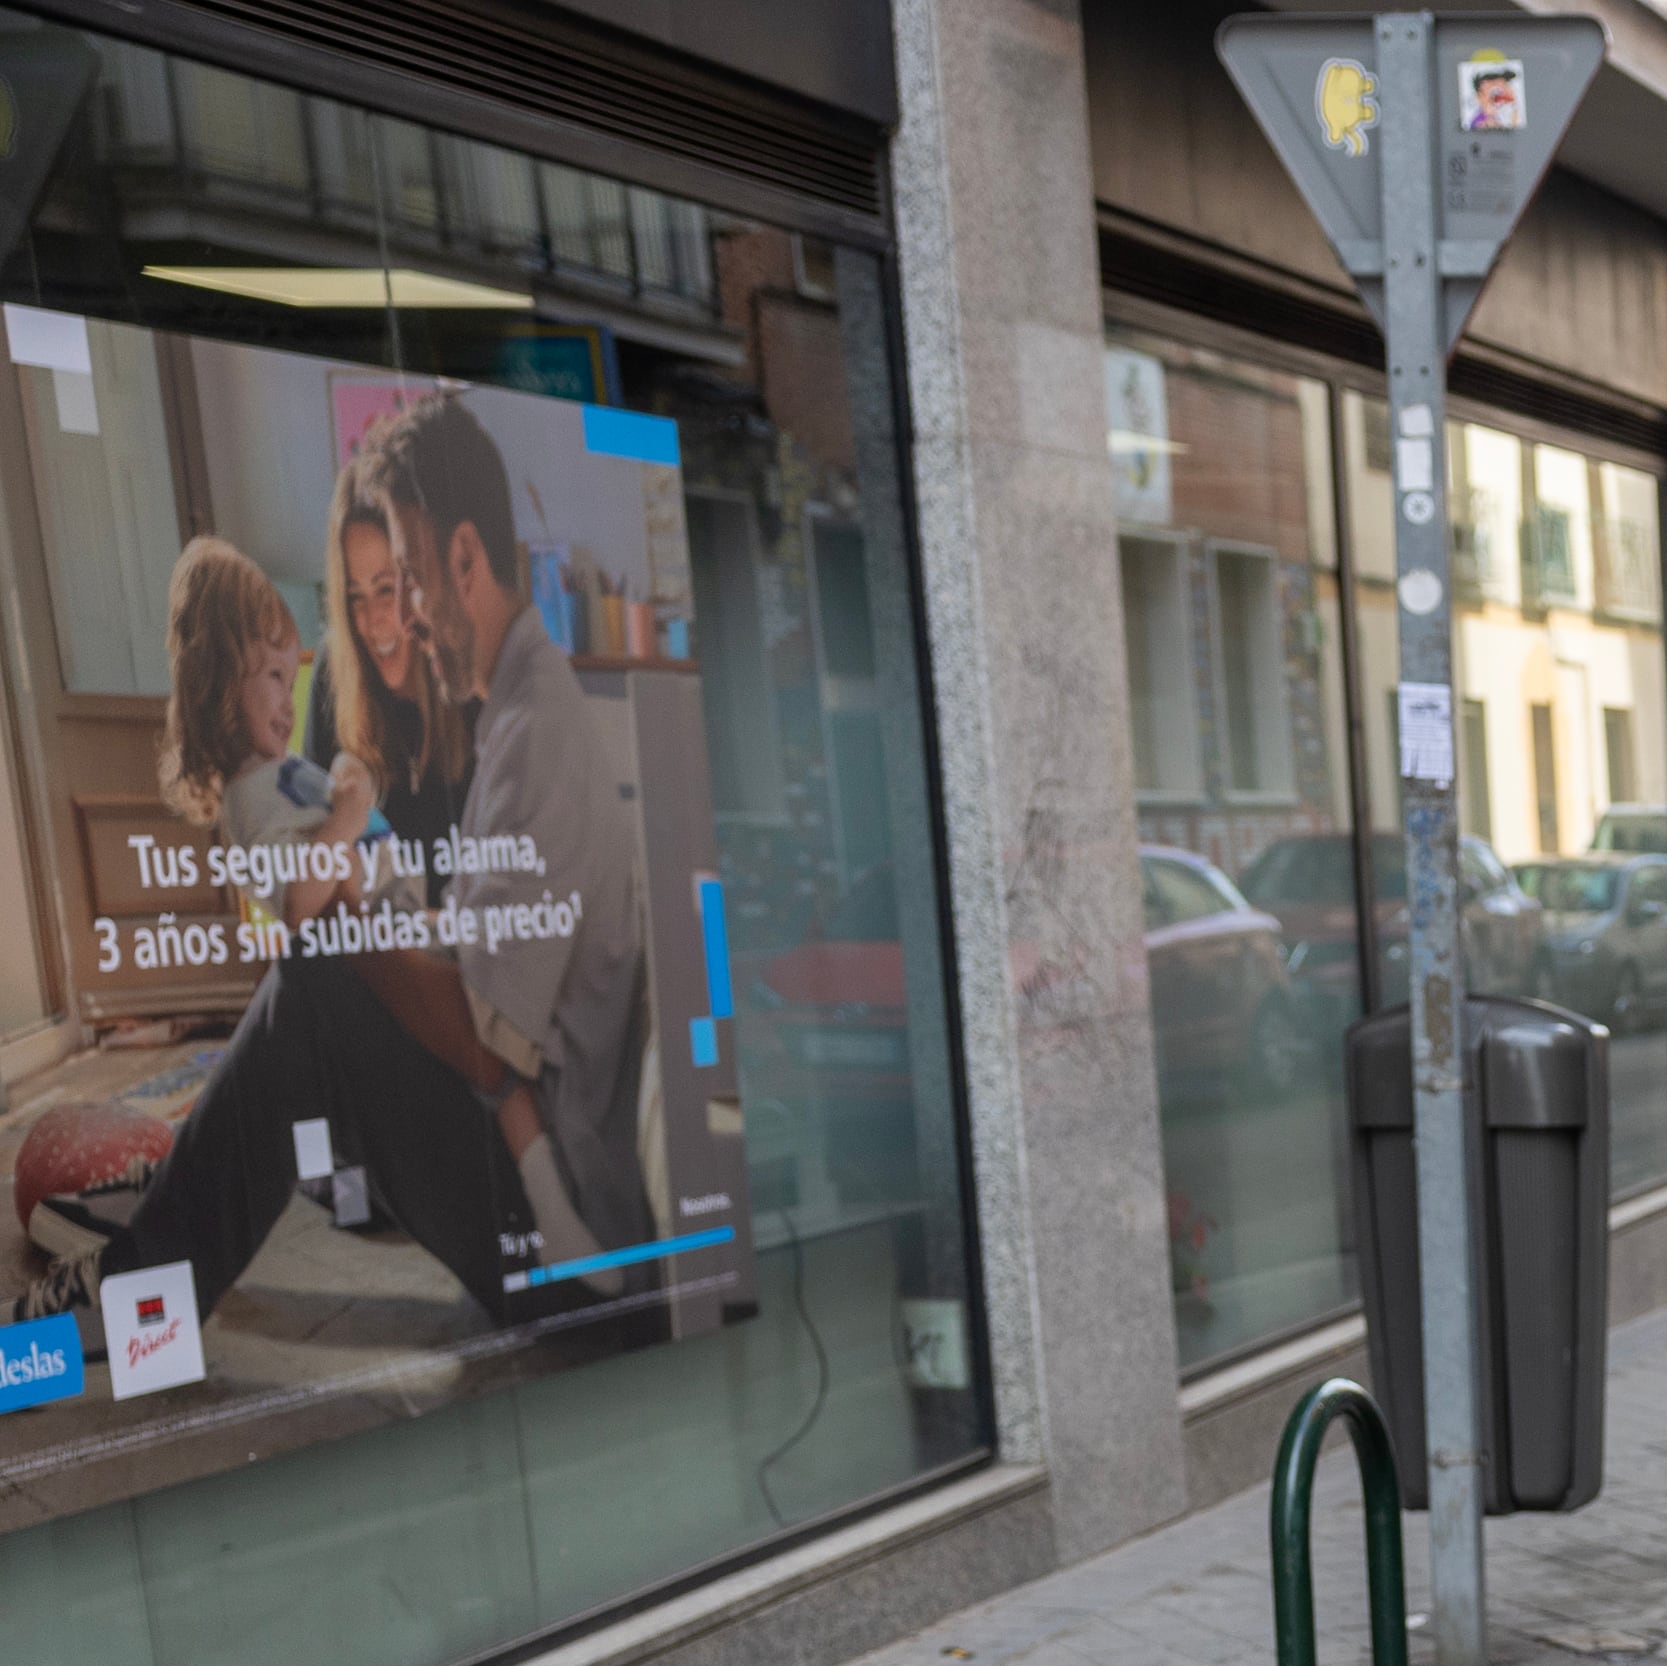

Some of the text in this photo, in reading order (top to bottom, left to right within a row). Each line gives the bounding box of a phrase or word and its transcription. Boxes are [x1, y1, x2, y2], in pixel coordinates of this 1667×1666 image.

[128, 834, 199, 889] Tus
[206, 838, 352, 898] seguros
[356, 836, 380, 892] y
[387, 831, 426, 878] tu
[94, 916, 122, 973] 3
[133, 911, 229, 970] años
[237, 906, 293, 963] sin
[300, 900, 431, 959] subidas
[436, 894, 478, 948] de
